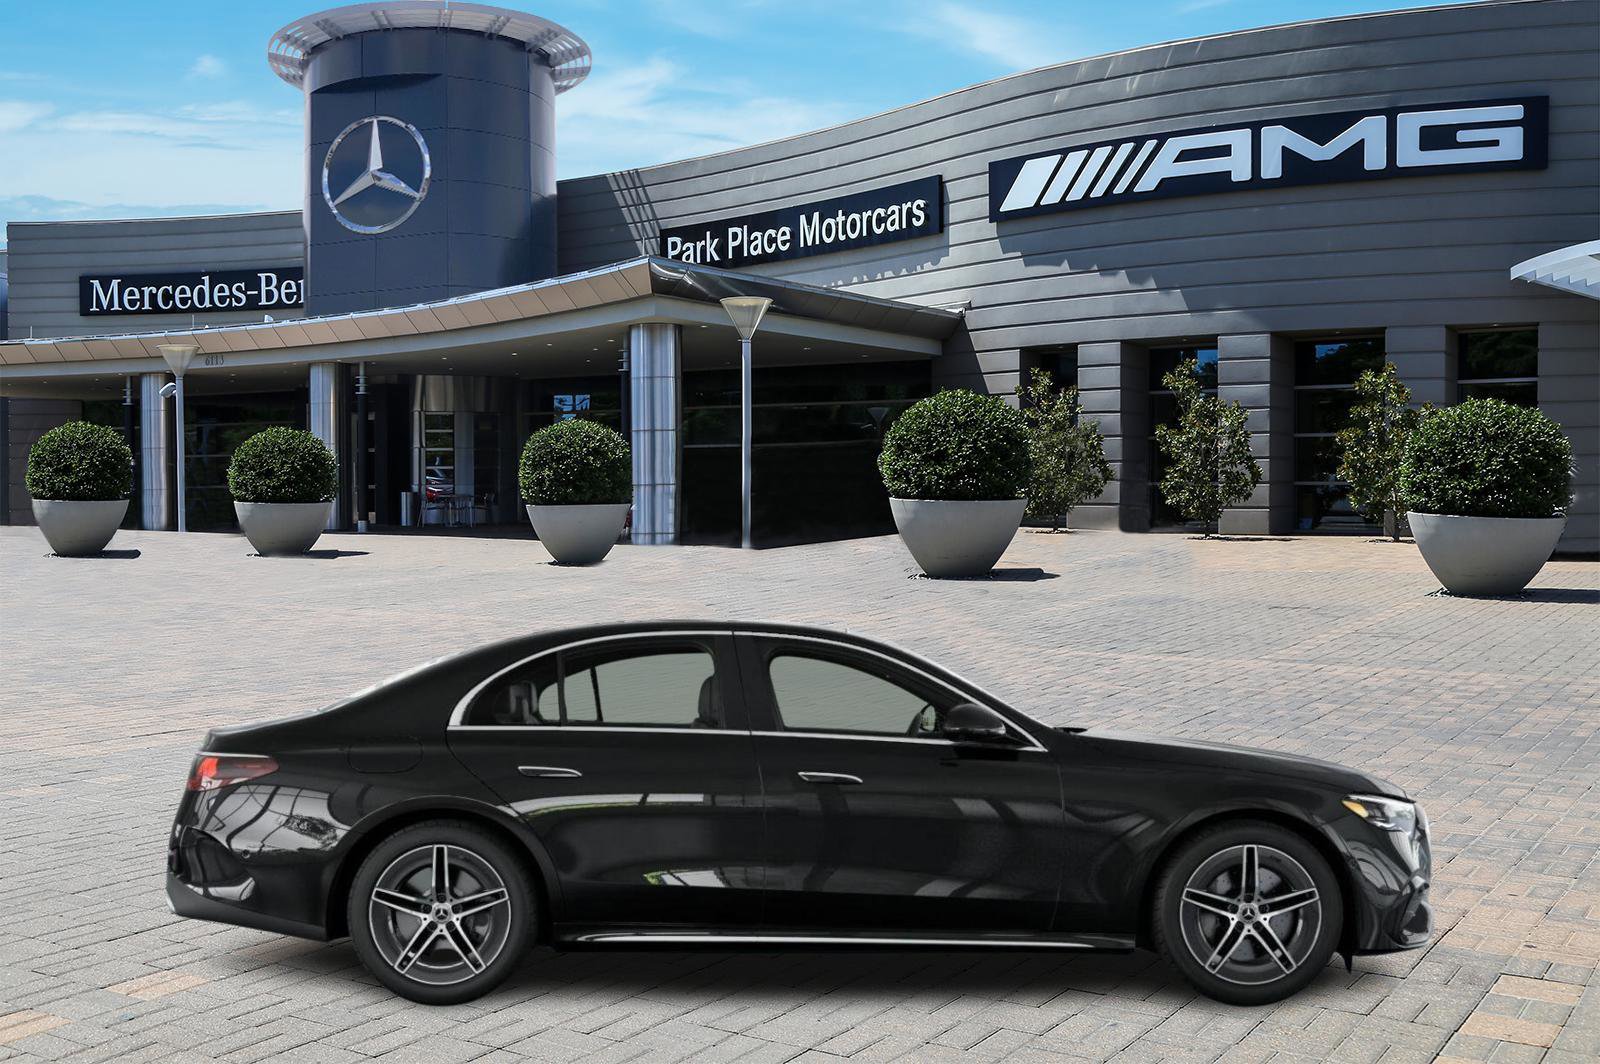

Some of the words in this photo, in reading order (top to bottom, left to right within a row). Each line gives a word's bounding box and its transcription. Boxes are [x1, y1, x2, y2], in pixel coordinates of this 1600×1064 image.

[1133, 104, 1525, 192] AMG
[667, 230, 720, 264] Park
[728, 225, 791, 259] Place
[800, 198, 926, 248] Motorcars
